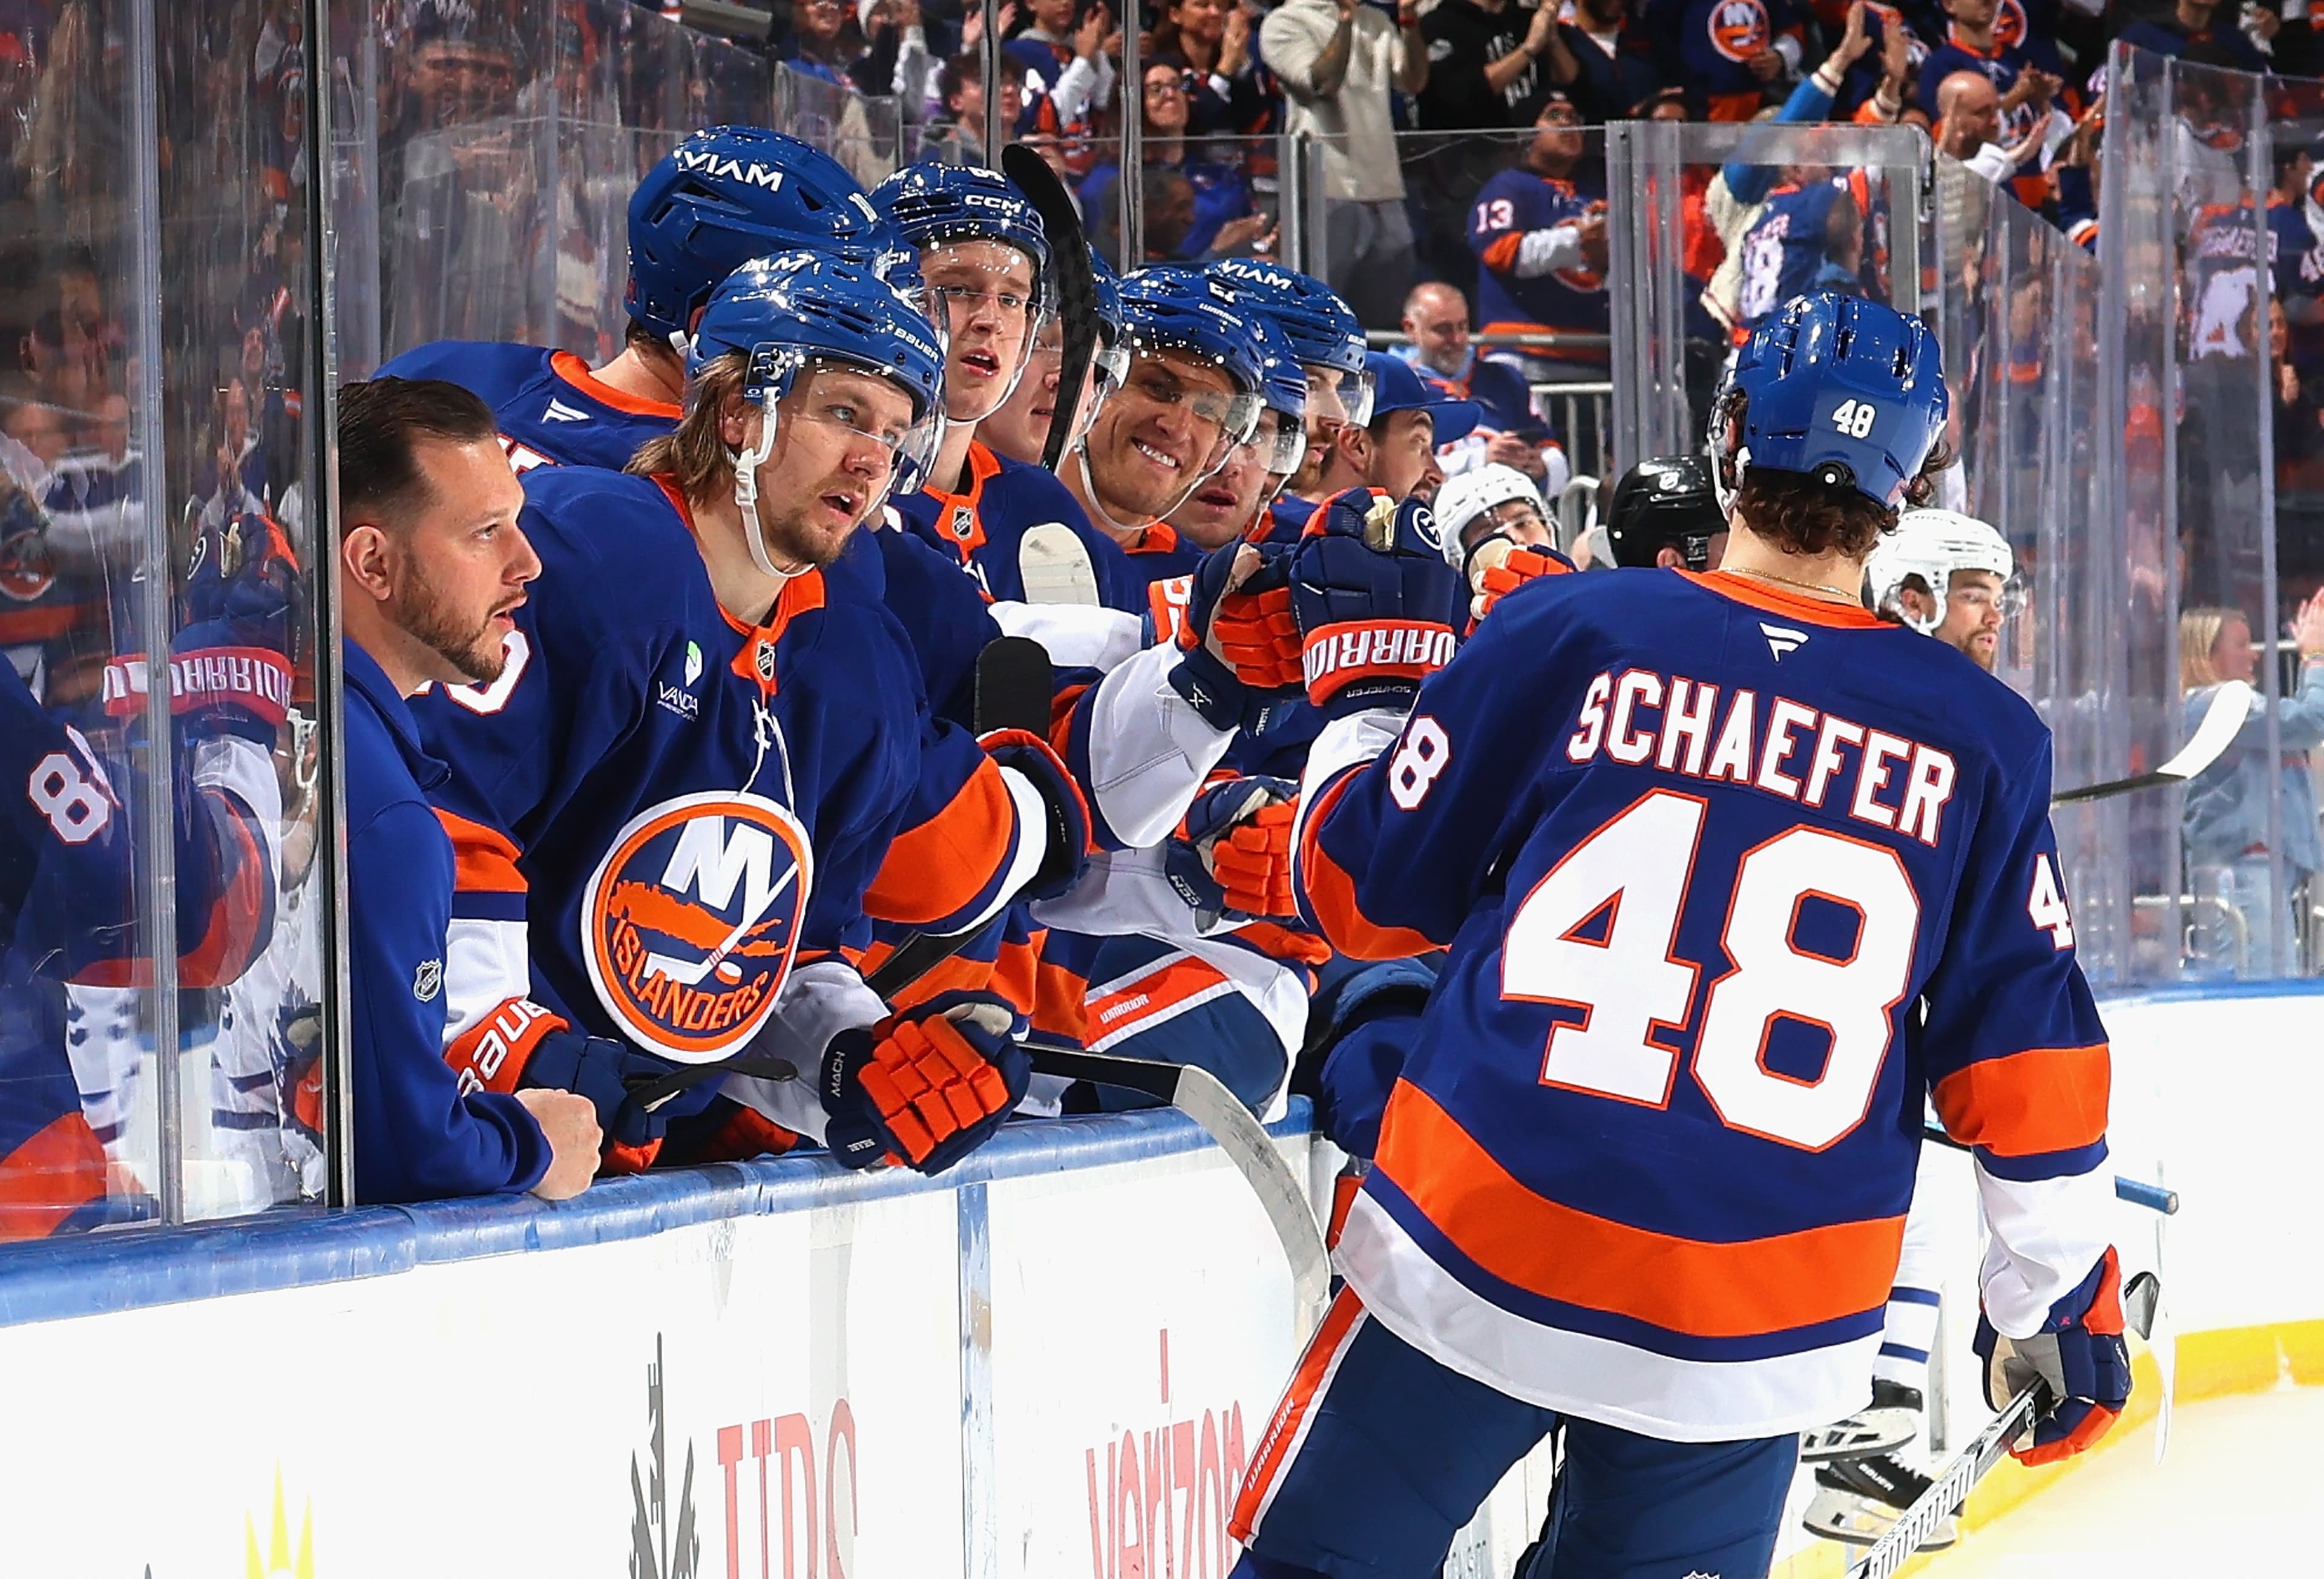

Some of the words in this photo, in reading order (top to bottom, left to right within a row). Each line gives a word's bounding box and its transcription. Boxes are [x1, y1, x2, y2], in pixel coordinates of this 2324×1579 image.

[684, 151, 784, 192] VIAM
[964, 194, 1022, 214] CCM
[1475, 198, 1514, 234] 13
[1220, 258, 1293, 291] VIAM
[1831, 397, 1877, 439] 48
[658, 681, 699, 716] VANDA
[1566, 667, 1958, 848] SCHAEFER
[611, 918, 769, 1031] ISLANDERS
[1500, 787, 1922, 1153] 48
[1099, 993, 1151, 1026] WARRIOR
[830, 1051, 846, 1098] MACH
[1247, 1397, 1296, 1492] WARRIOR
